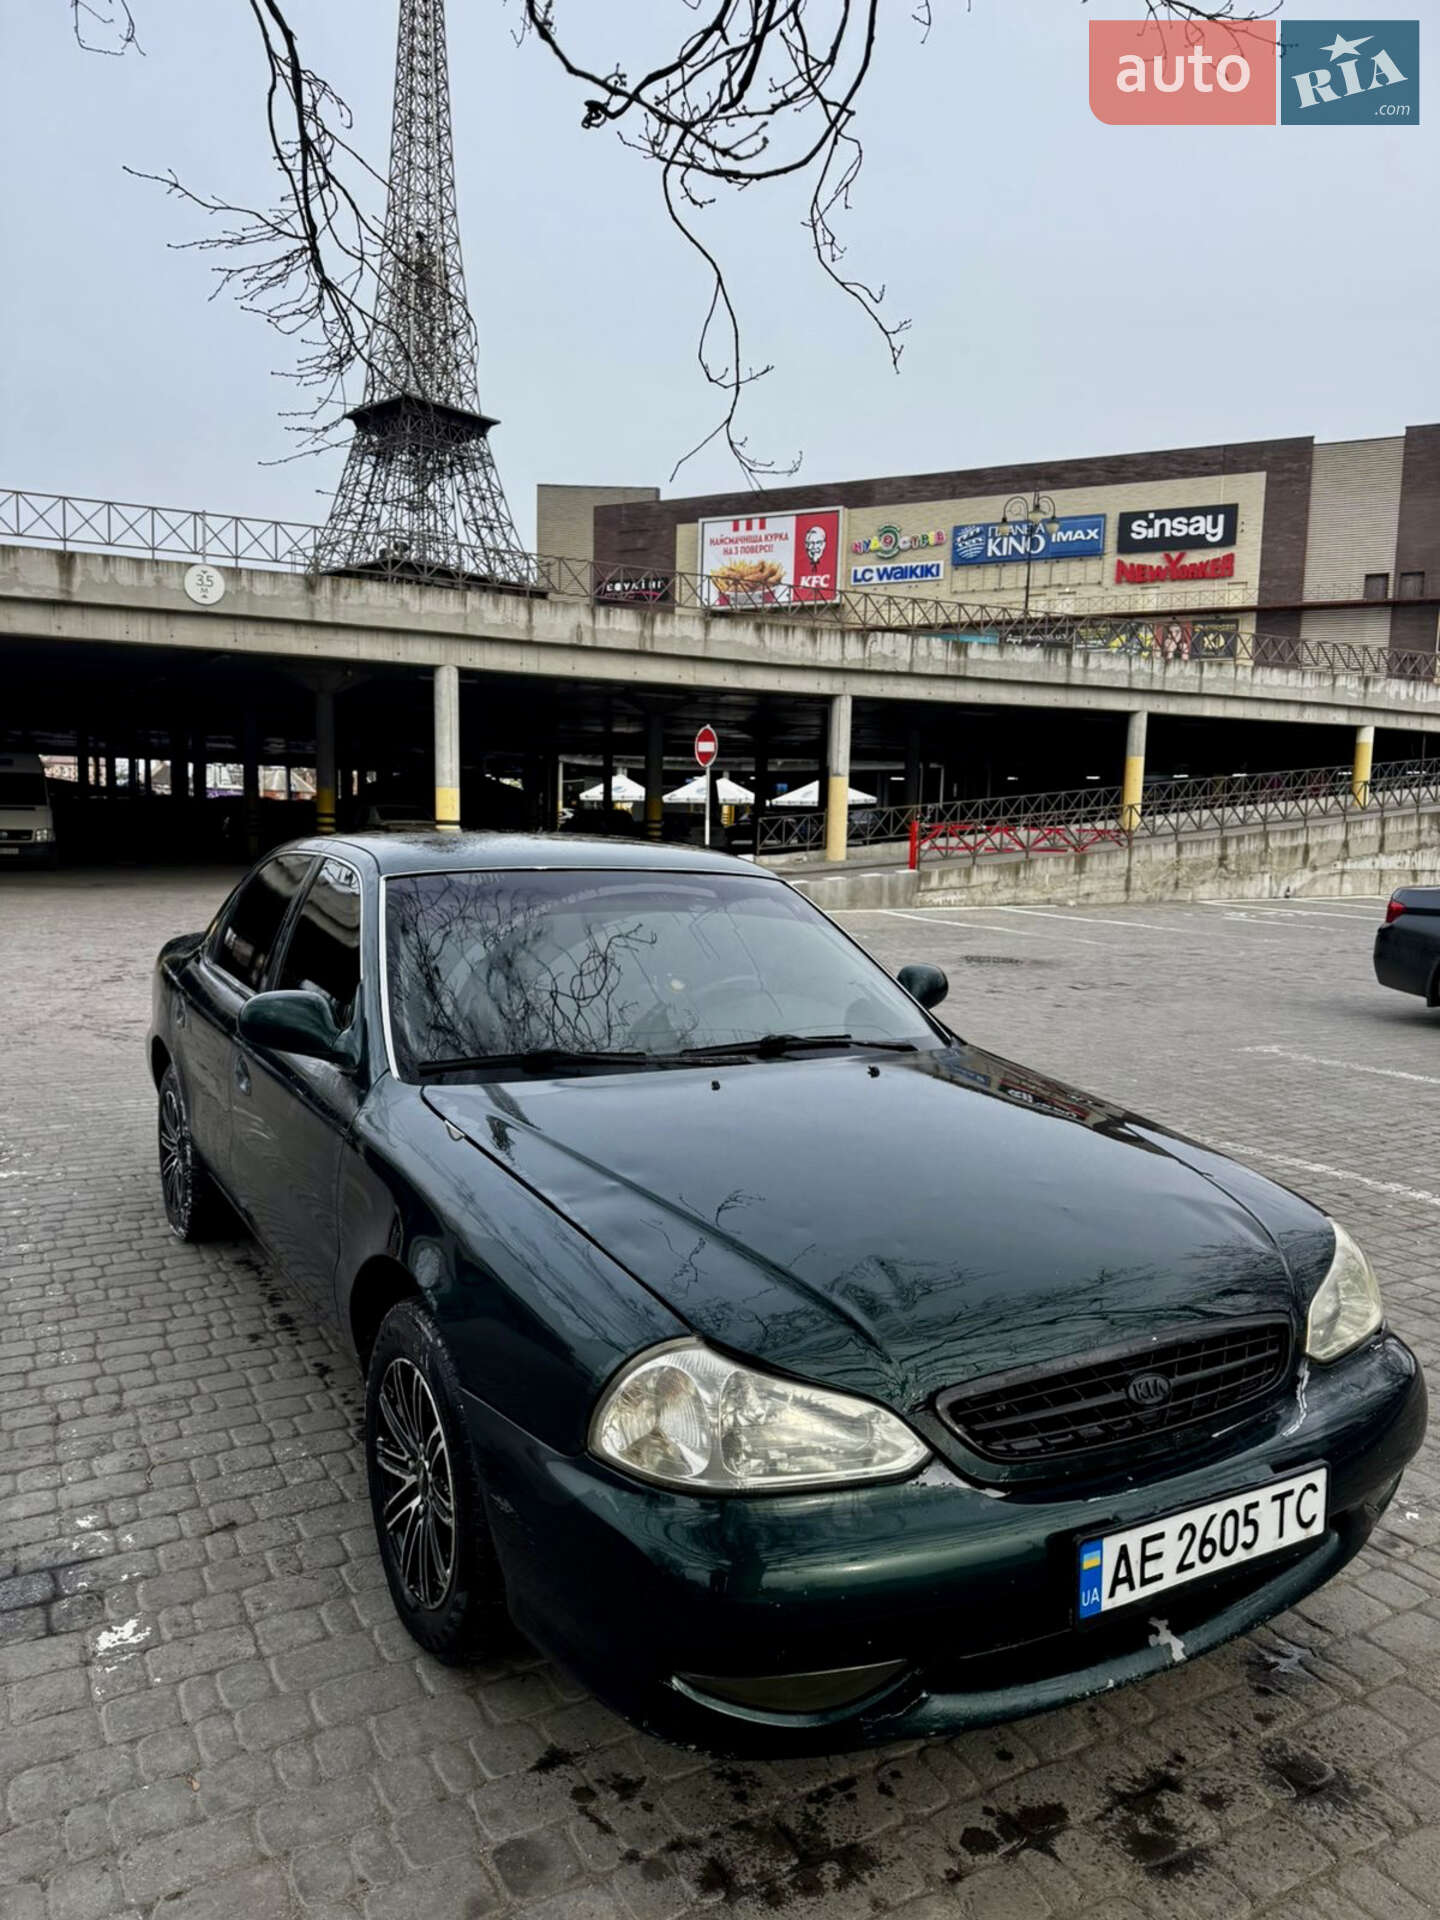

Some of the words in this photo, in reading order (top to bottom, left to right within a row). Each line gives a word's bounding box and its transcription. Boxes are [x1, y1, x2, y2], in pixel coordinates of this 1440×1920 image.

[1051, 528, 1099, 543] IMAX
[1130, 512, 1225, 543] sinsay
[987, 534, 1046, 557] KINO
[800, 574, 831, 588] KFC
[853, 568, 874, 583] LC
[1134, 1379, 1168, 1401] KIA
[1108, 1531, 1166, 1599] AE
[1176, 1500, 1260, 1575] 2605
[1271, 1482, 1319, 1539] TC
[1081, 1587, 1100, 1607] UA
